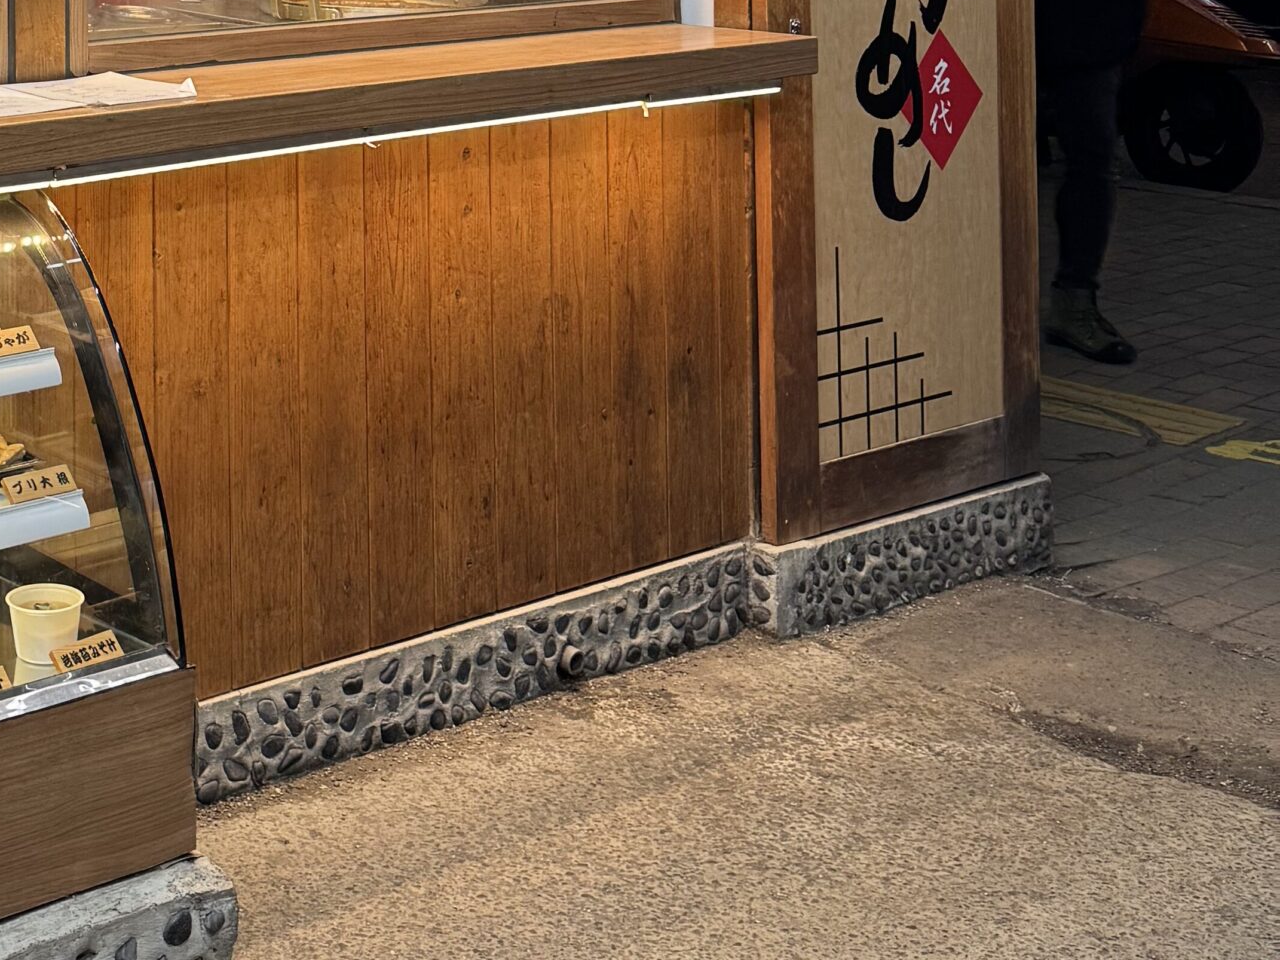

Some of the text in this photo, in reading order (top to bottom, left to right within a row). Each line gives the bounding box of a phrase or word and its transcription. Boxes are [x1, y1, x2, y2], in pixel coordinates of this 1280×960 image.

[928, 57, 954, 136] 名代
[11, 471, 70, 495] ブリ大根
